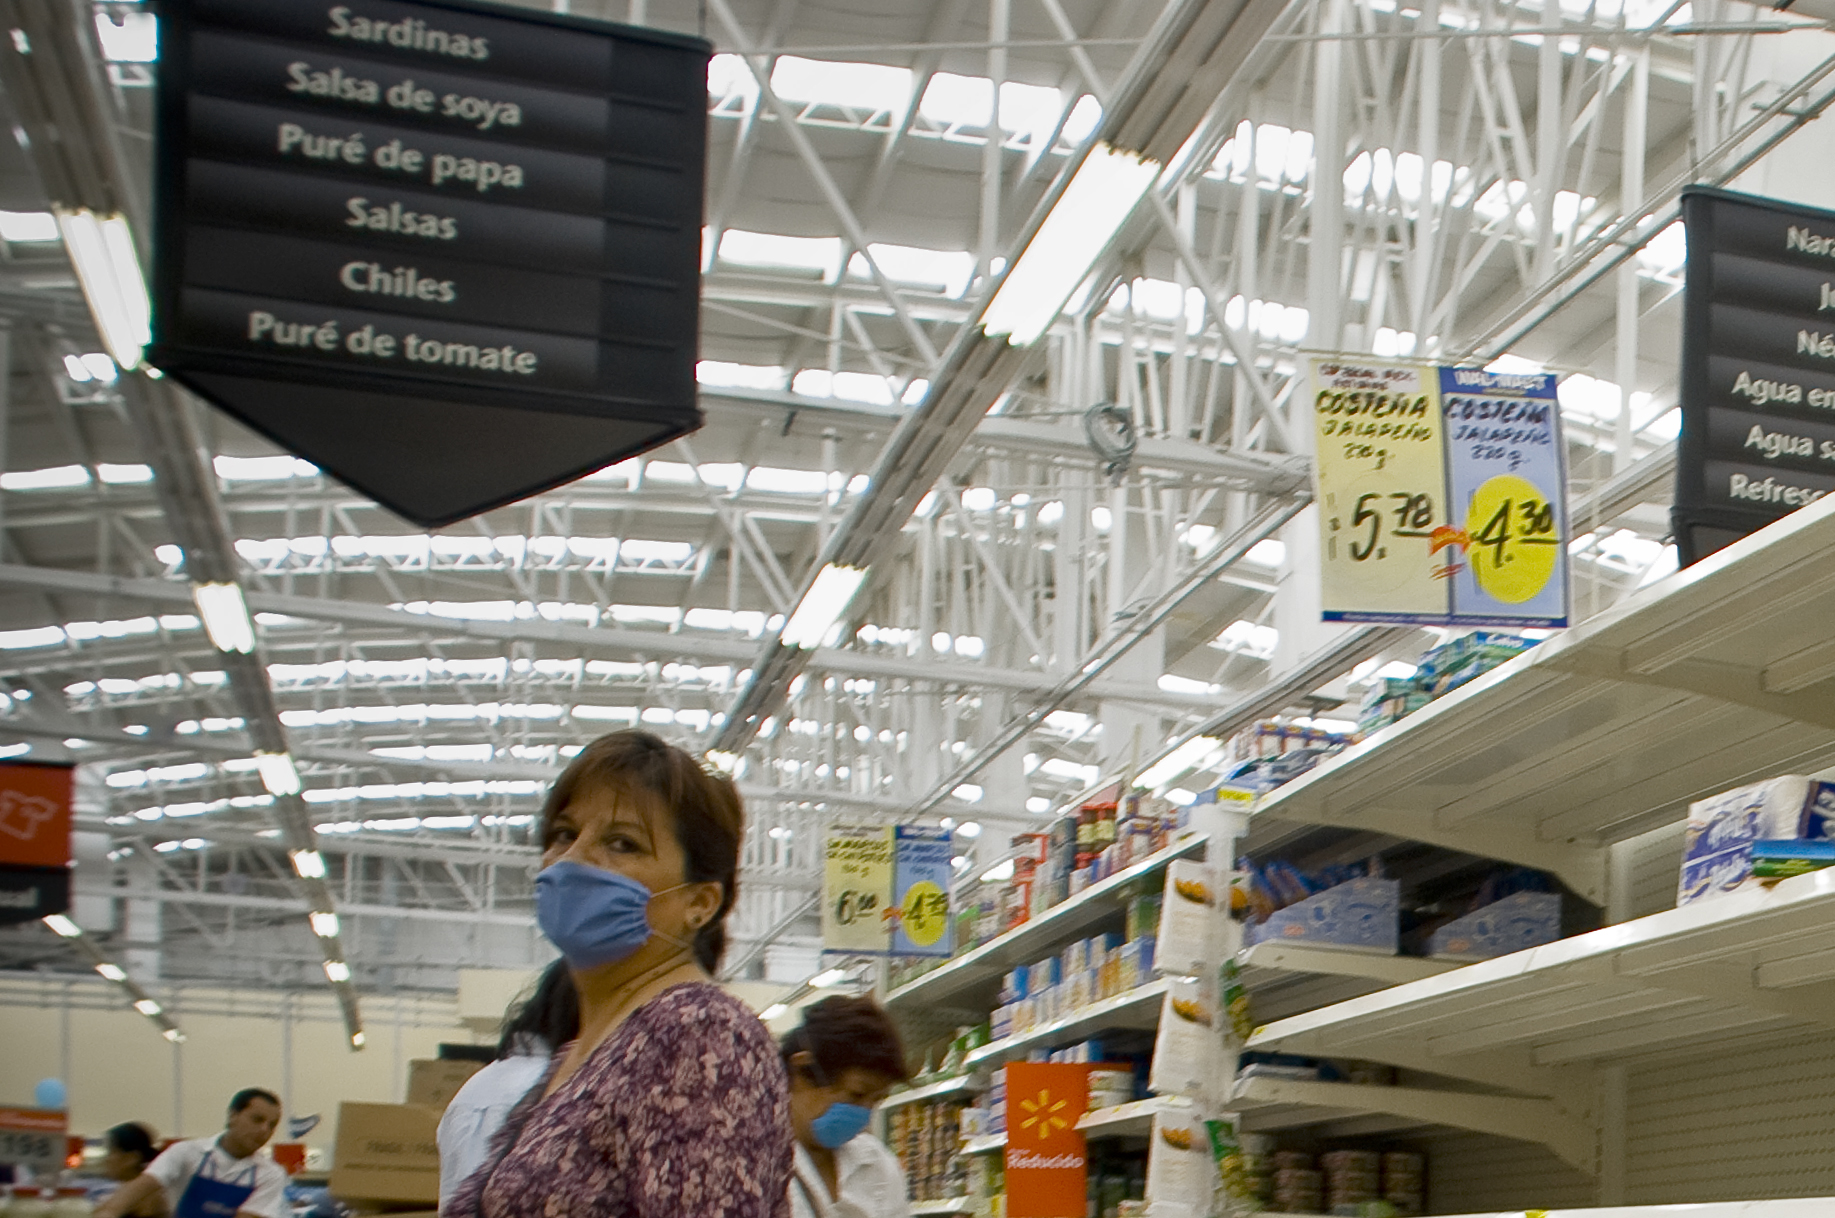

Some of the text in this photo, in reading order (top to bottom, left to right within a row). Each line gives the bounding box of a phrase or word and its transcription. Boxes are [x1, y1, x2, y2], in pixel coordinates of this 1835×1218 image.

[328, 7, 489, 60] Sardinas
[287, 62, 523, 129] Salsa de soya
[278, 123, 524, 191] Puré de papa
[346, 197, 457, 241] Salsas
[340, 260, 456, 303] Chiles
[249, 311, 538, 375] Puré de tomate
[1731, 371, 1801, 406] Agua
[1744, 425, 1813, 459] Agua
